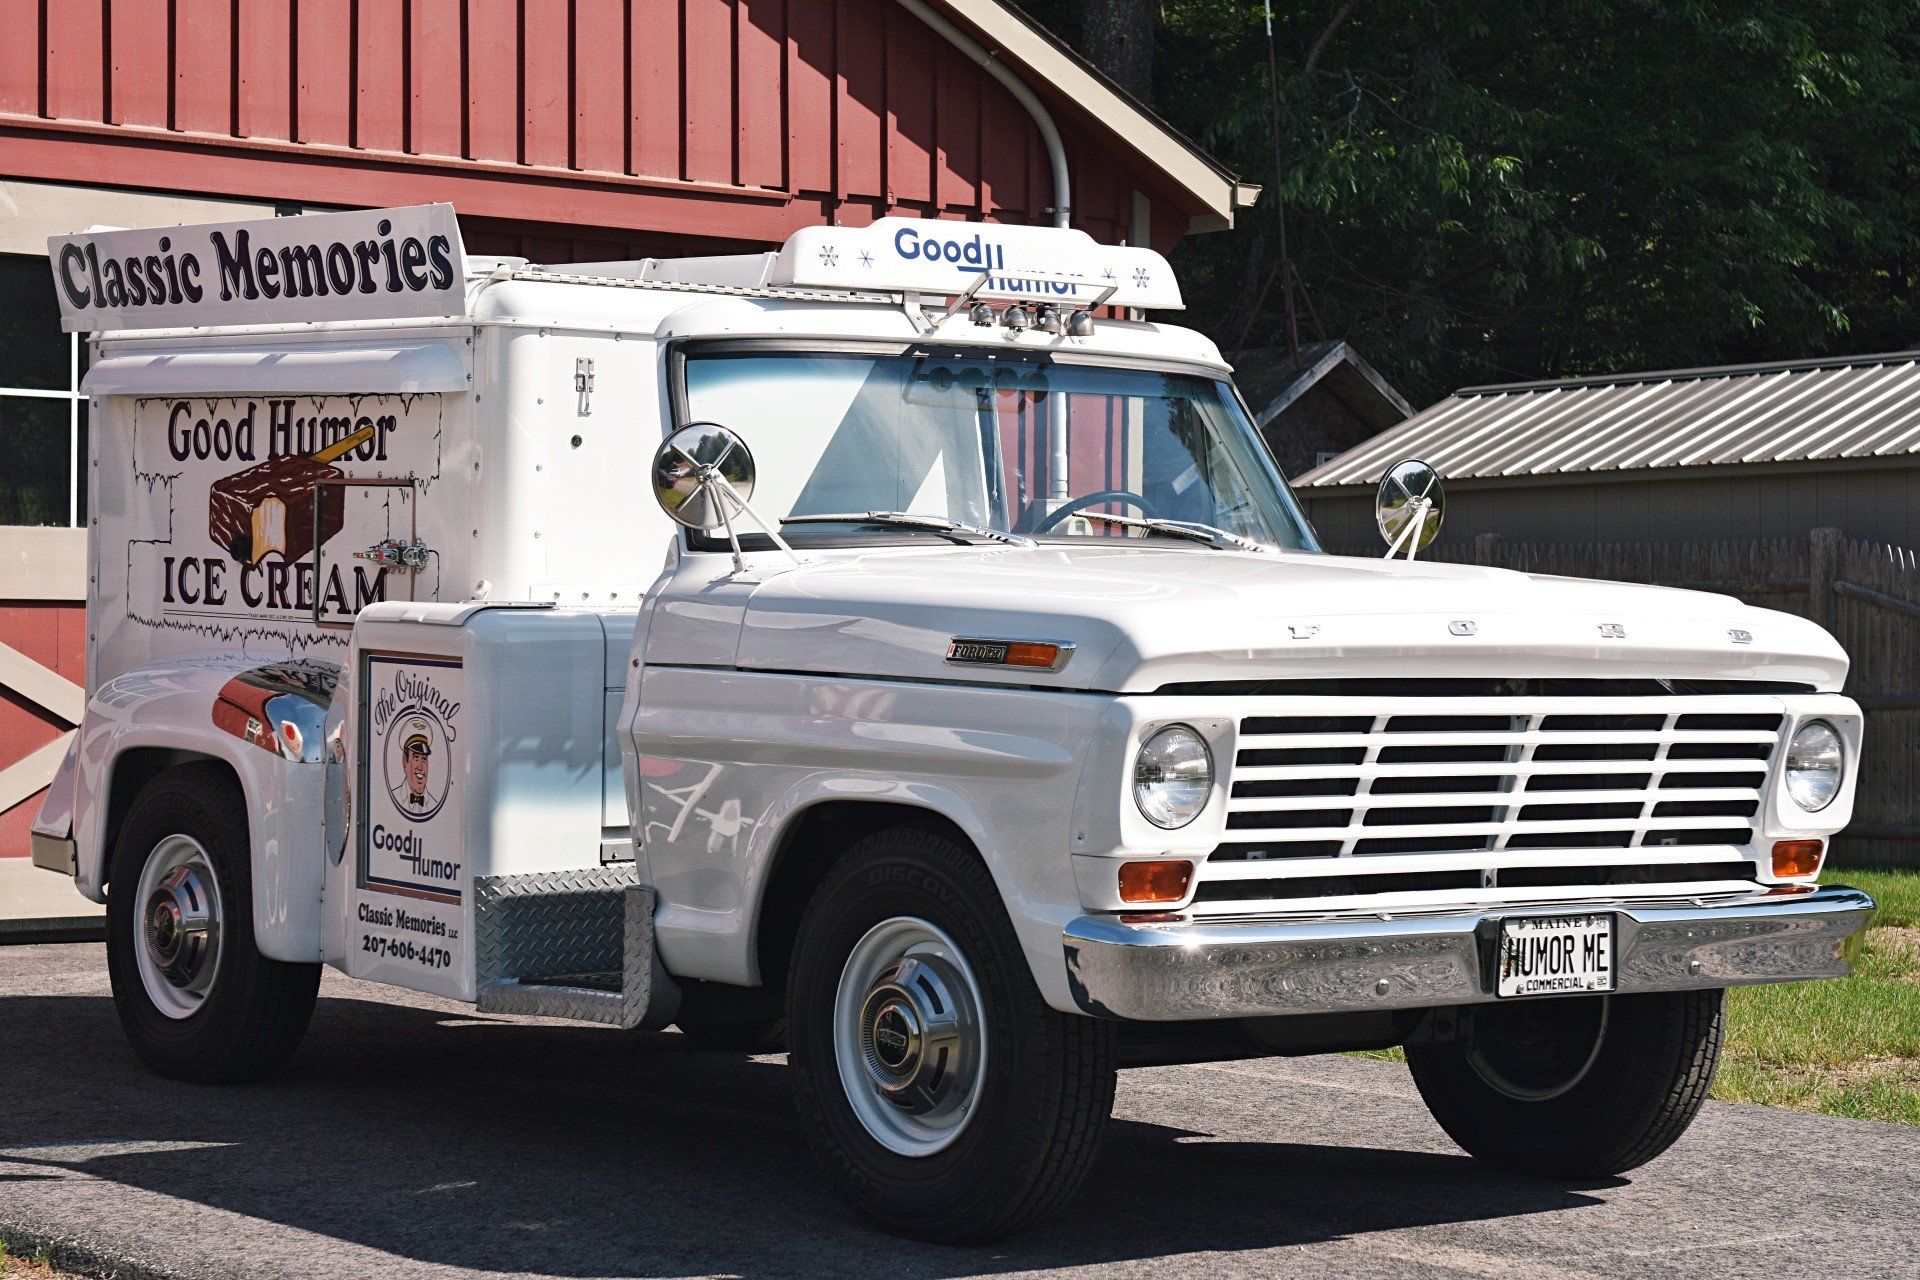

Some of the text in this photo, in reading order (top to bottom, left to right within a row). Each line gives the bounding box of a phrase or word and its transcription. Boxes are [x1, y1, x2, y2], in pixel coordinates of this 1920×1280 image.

[59, 219, 454, 309] Classic Memories
[894, 227, 982, 264] Good
[168, 400, 397, 461] Good Humor
[163, 556, 388, 615] ICE CREAM
[375, 669, 461, 742] The Original
[373, 824, 461, 881] Good Humor
[358, 903, 459, 939] Classic Memories LLC
[1532, 918, 1582, 930] MAINE
[363, 935, 451, 969] 207-606-4470
[1506, 932, 1608, 977] HUMOR ME
[1526, 977, 1584, 991] COMMERCIAL
